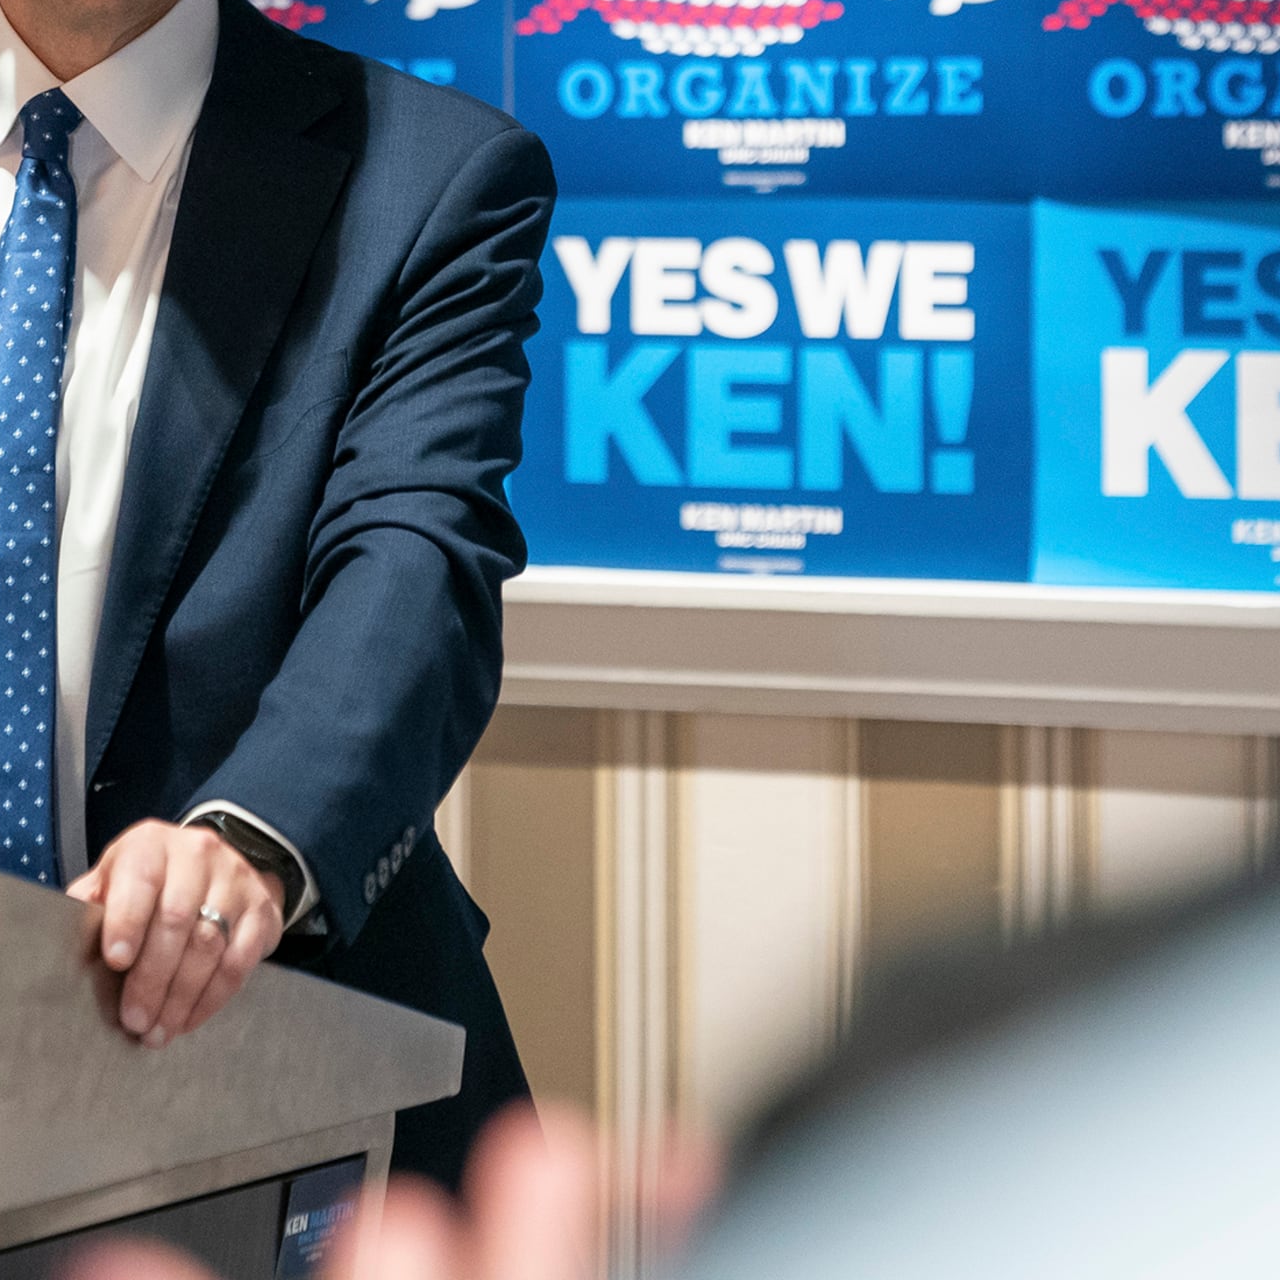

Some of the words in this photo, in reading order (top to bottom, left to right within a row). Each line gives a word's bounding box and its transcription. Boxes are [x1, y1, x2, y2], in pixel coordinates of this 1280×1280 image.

[557, 57, 983, 119] ORGANIZE
[552, 235, 778, 339] YES
[784, 239, 975, 340] WE
[564, 340, 975, 494] KEN!
